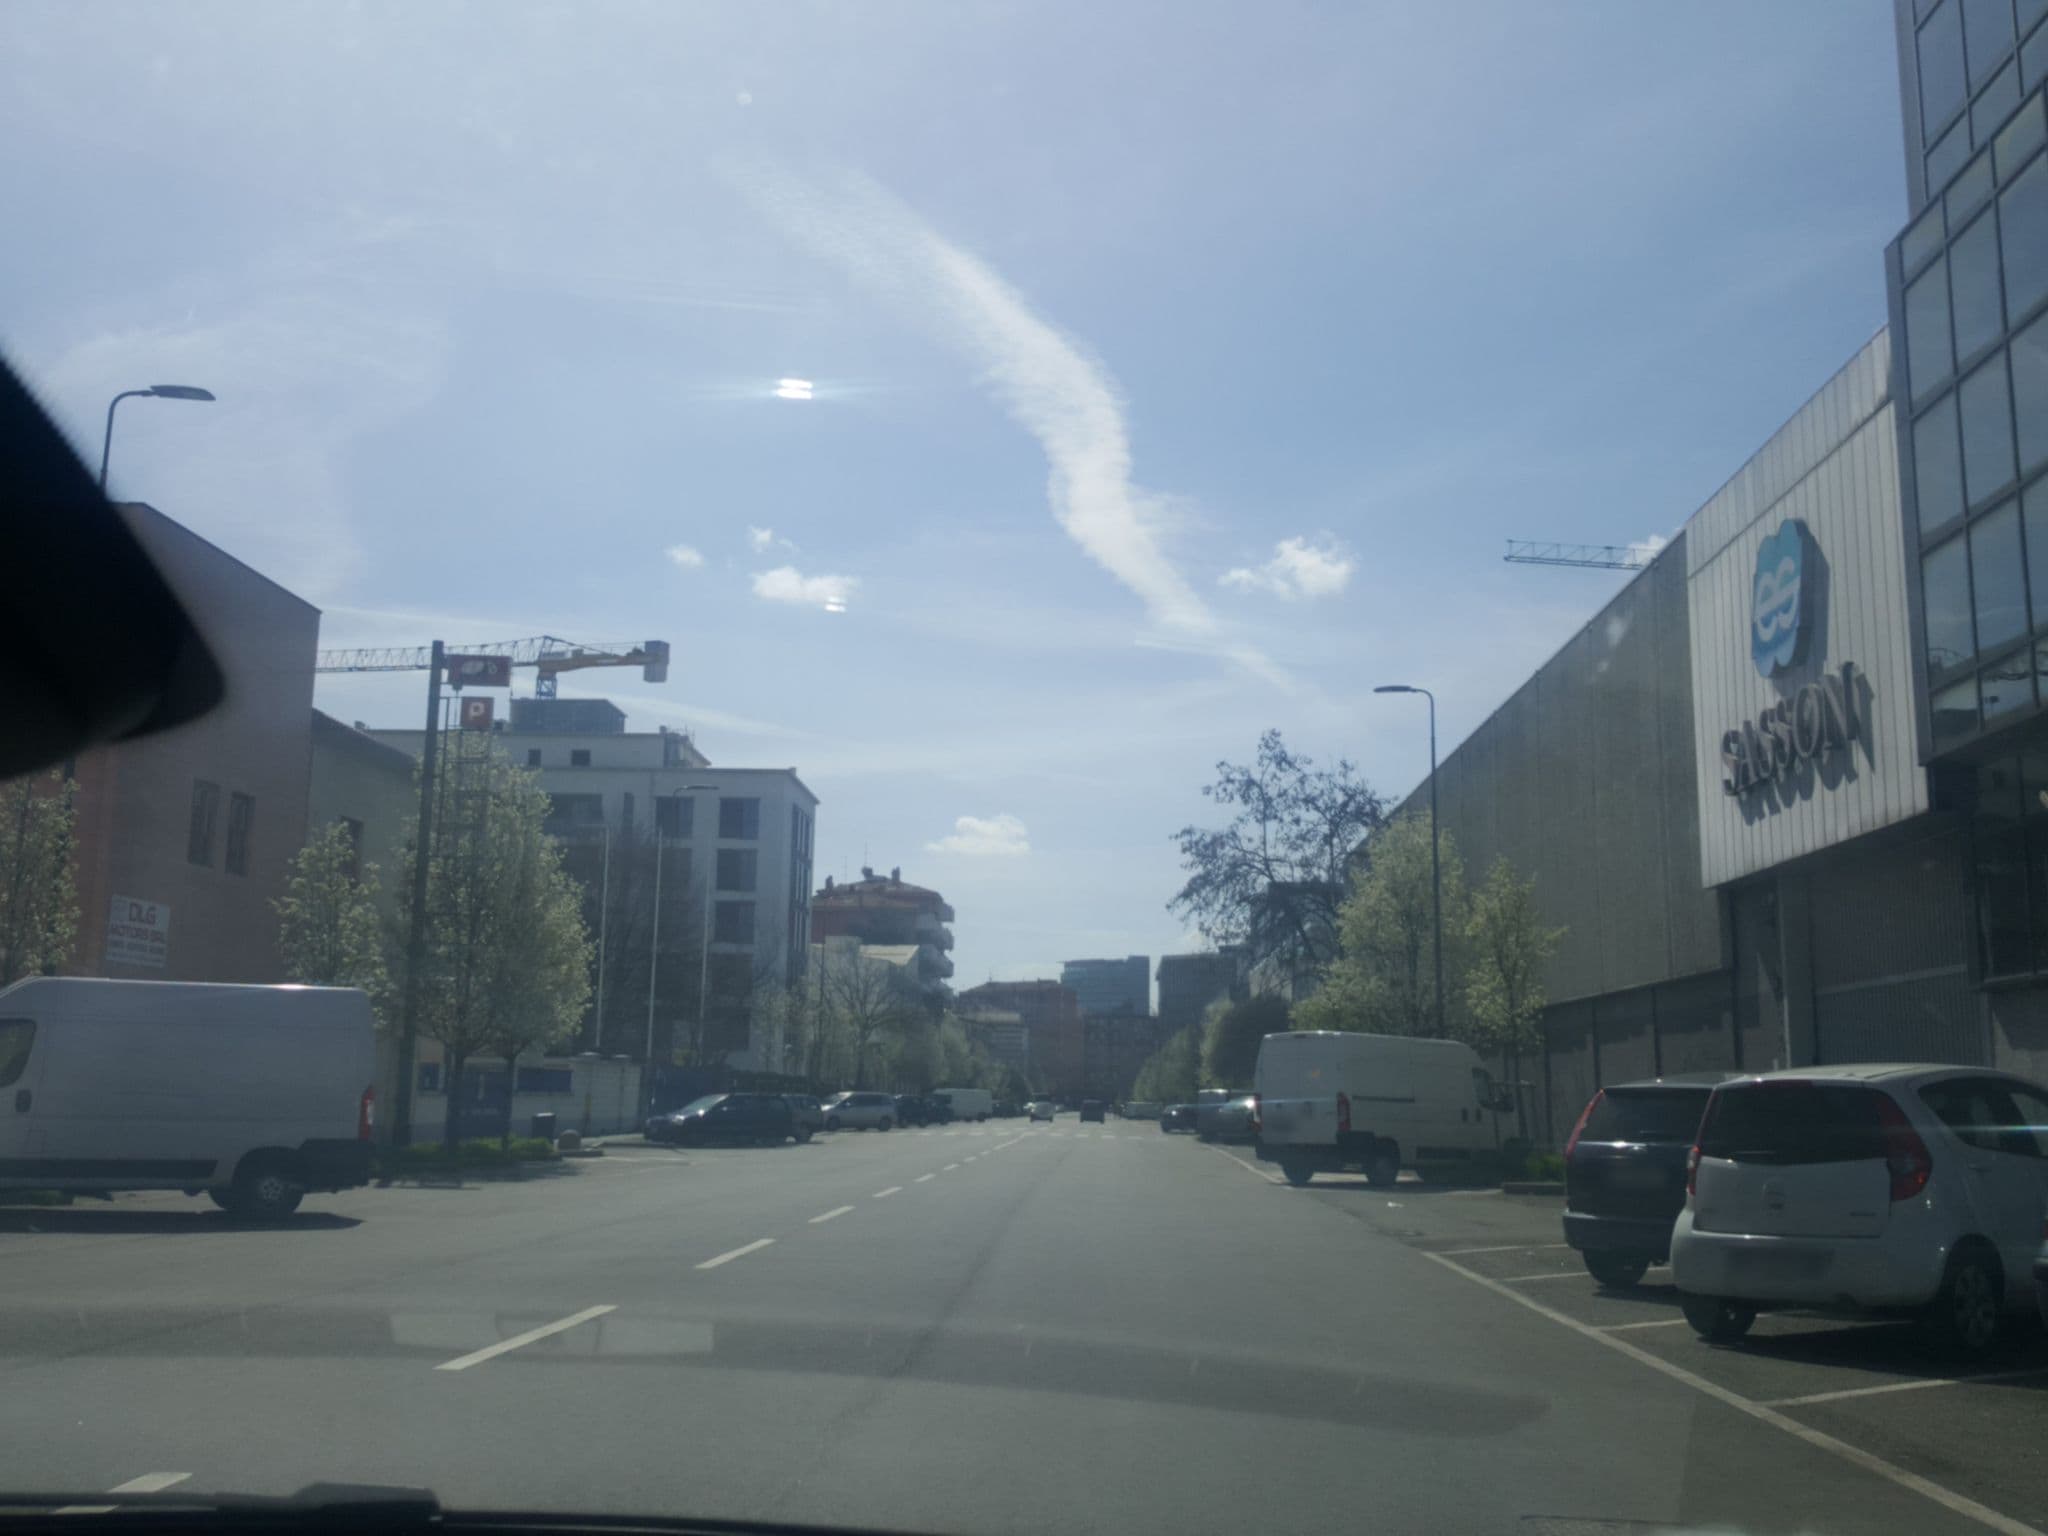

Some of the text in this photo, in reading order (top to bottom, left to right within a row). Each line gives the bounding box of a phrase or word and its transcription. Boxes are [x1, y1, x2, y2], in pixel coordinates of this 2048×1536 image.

[469, 701, 485, 722] P
[1721, 661, 1864, 797] SASSON
[128, 902, 157, 925] DLG
